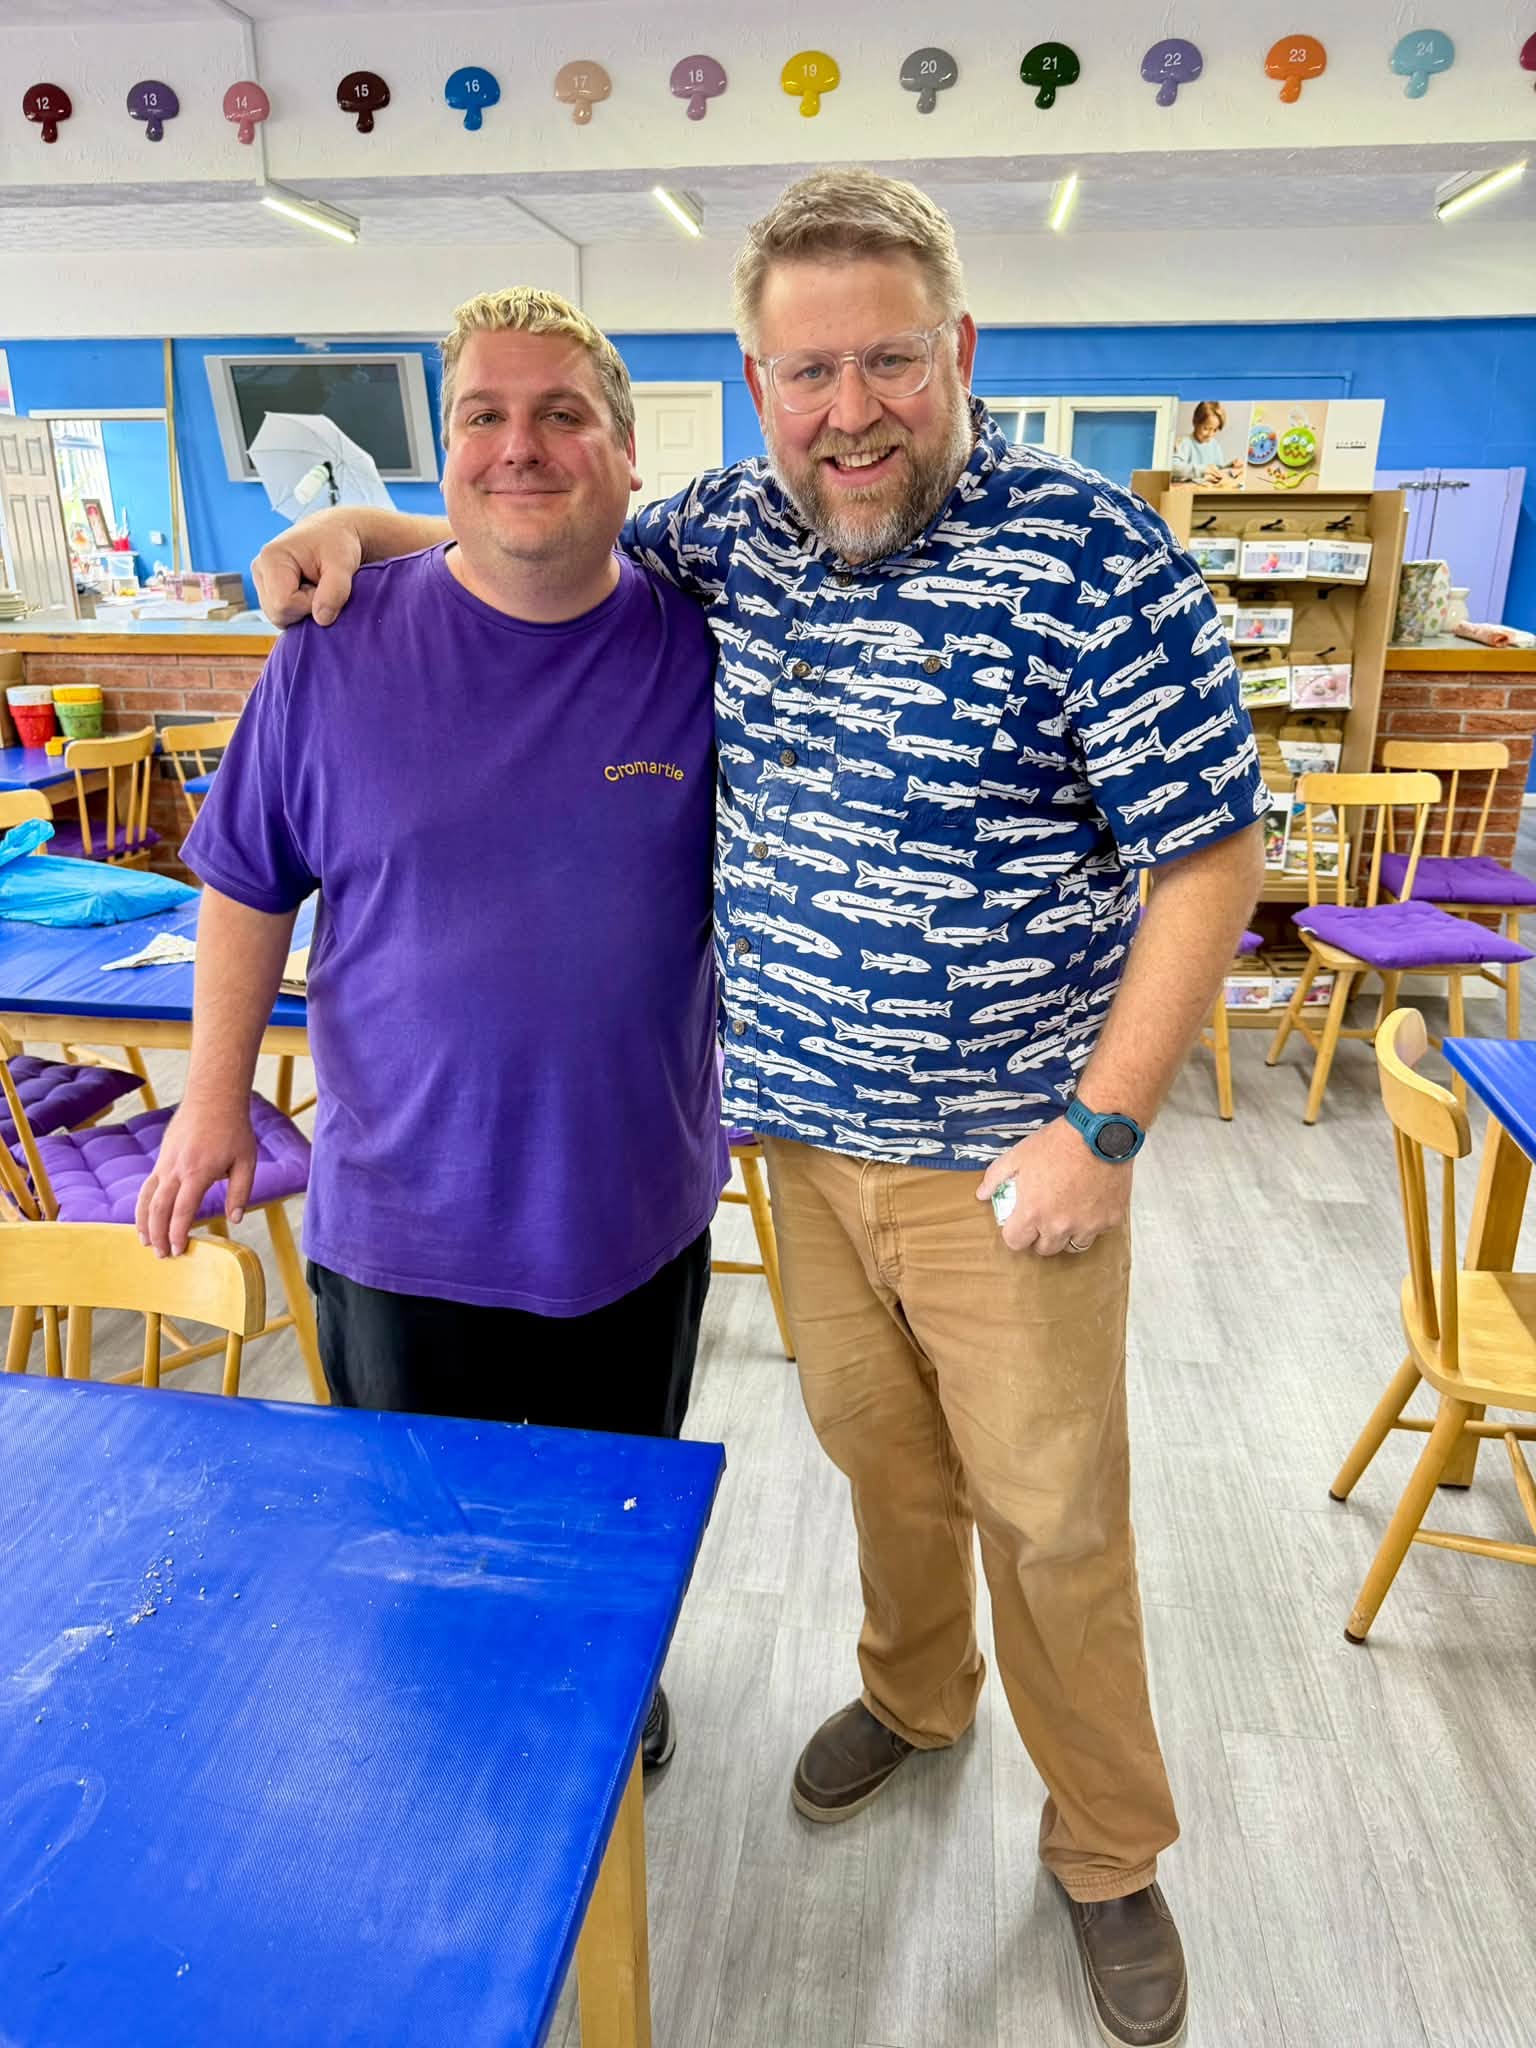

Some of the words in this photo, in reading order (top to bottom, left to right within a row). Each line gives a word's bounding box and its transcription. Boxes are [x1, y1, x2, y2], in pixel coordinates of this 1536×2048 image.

[1415, 40, 1434, 56] 24
[1164, 53, 1182, 67] 22
[1289, 49, 1306, 62] 23
[802, 63, 817, 76] 19
[920, 60, 937, 74] 20
[1042, 56, 1058, 70] 21
[573, 75, 588, 88] 17
[689, 69, 704, 83] 18
[354, 84, 369, 97] 15
[465, 79, 480, 93] 16
[36, 97, 50, 110] 12
[143, 92, 157, 106] 13
[235, 96, 248, 109] 14
[604, 761, 684, 782] Cromartie
